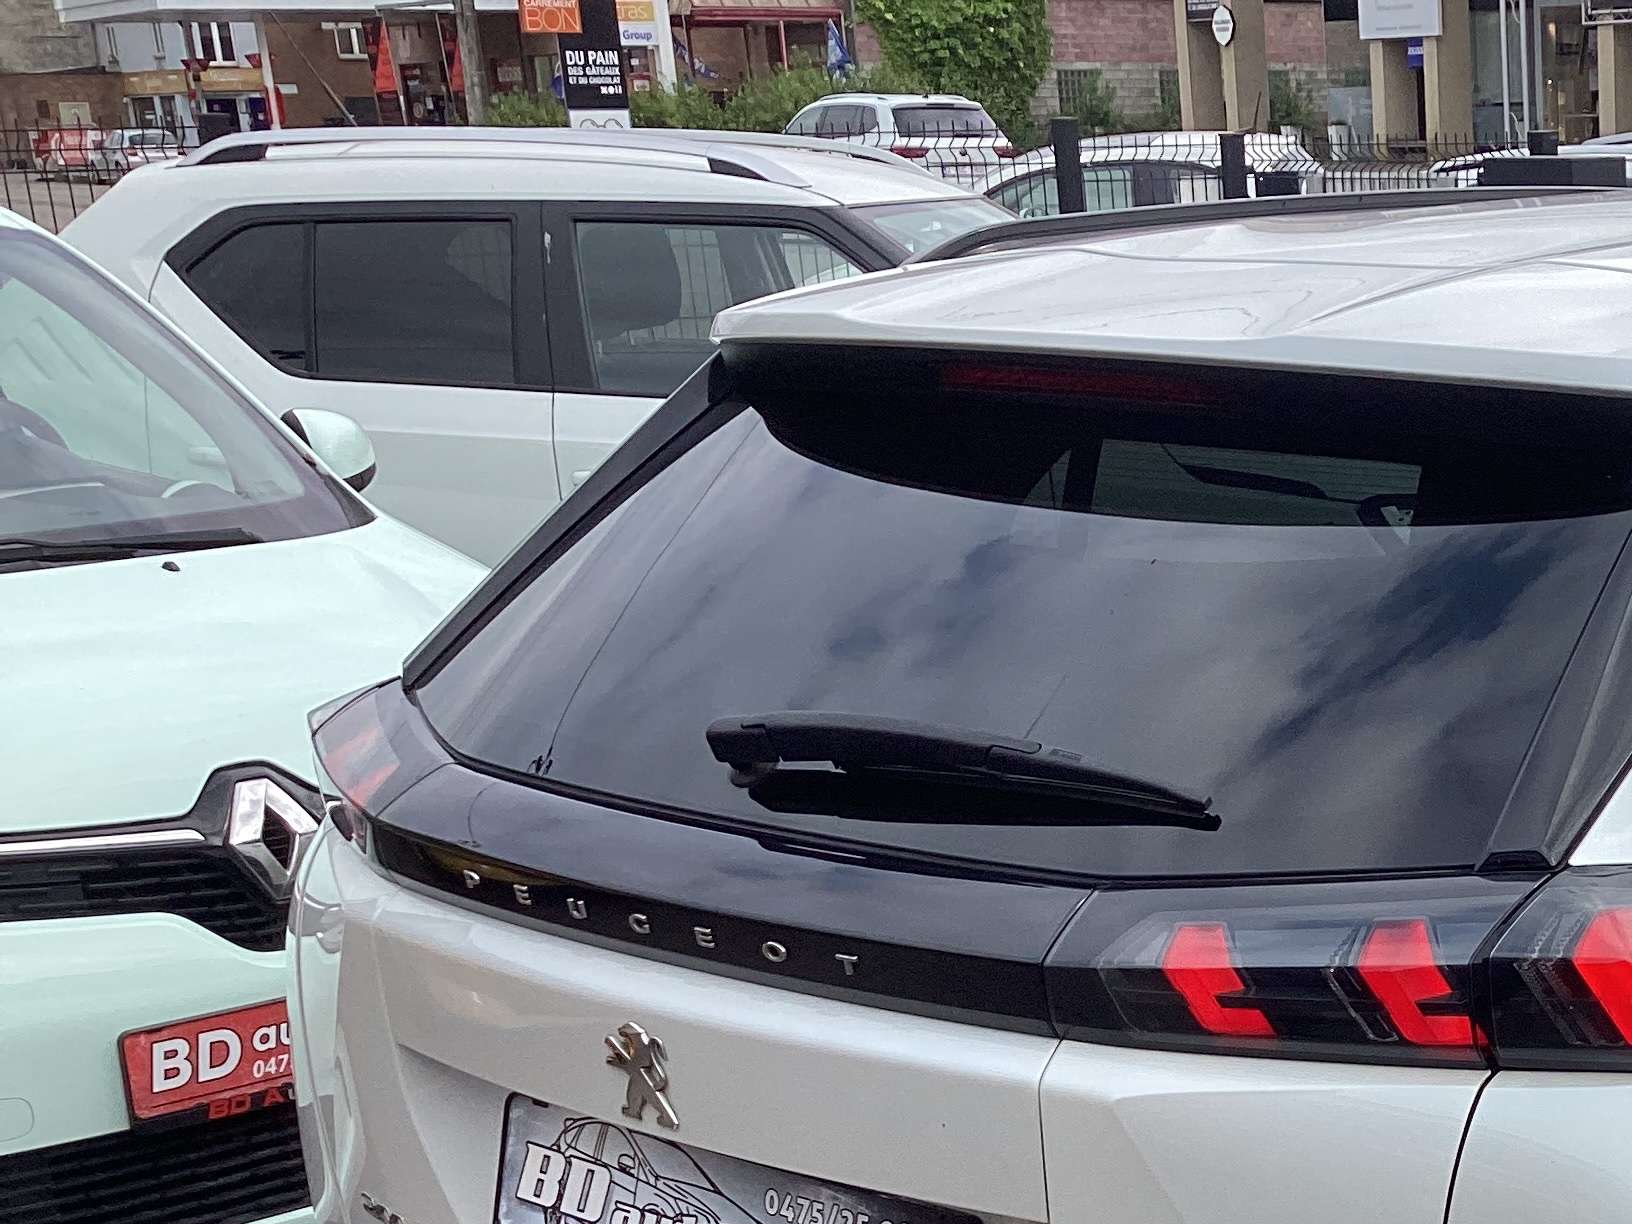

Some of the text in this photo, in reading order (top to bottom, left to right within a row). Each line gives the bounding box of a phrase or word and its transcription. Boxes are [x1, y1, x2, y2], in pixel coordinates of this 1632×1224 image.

[525, 7, 580, 31] BON
[622, 30, 653, 42] Group
[565, 50, 619, 65] DU PAIN
[567, 66, 584, 75] DES
[463, 869, 859, 976] PEUGEOT
[151, 1028, 243, 1094] BD
[252, 1053, 292, 1079] 047
[208, 1093, 251, 1120] BD
[515, 1141, 612, 1223] BD
